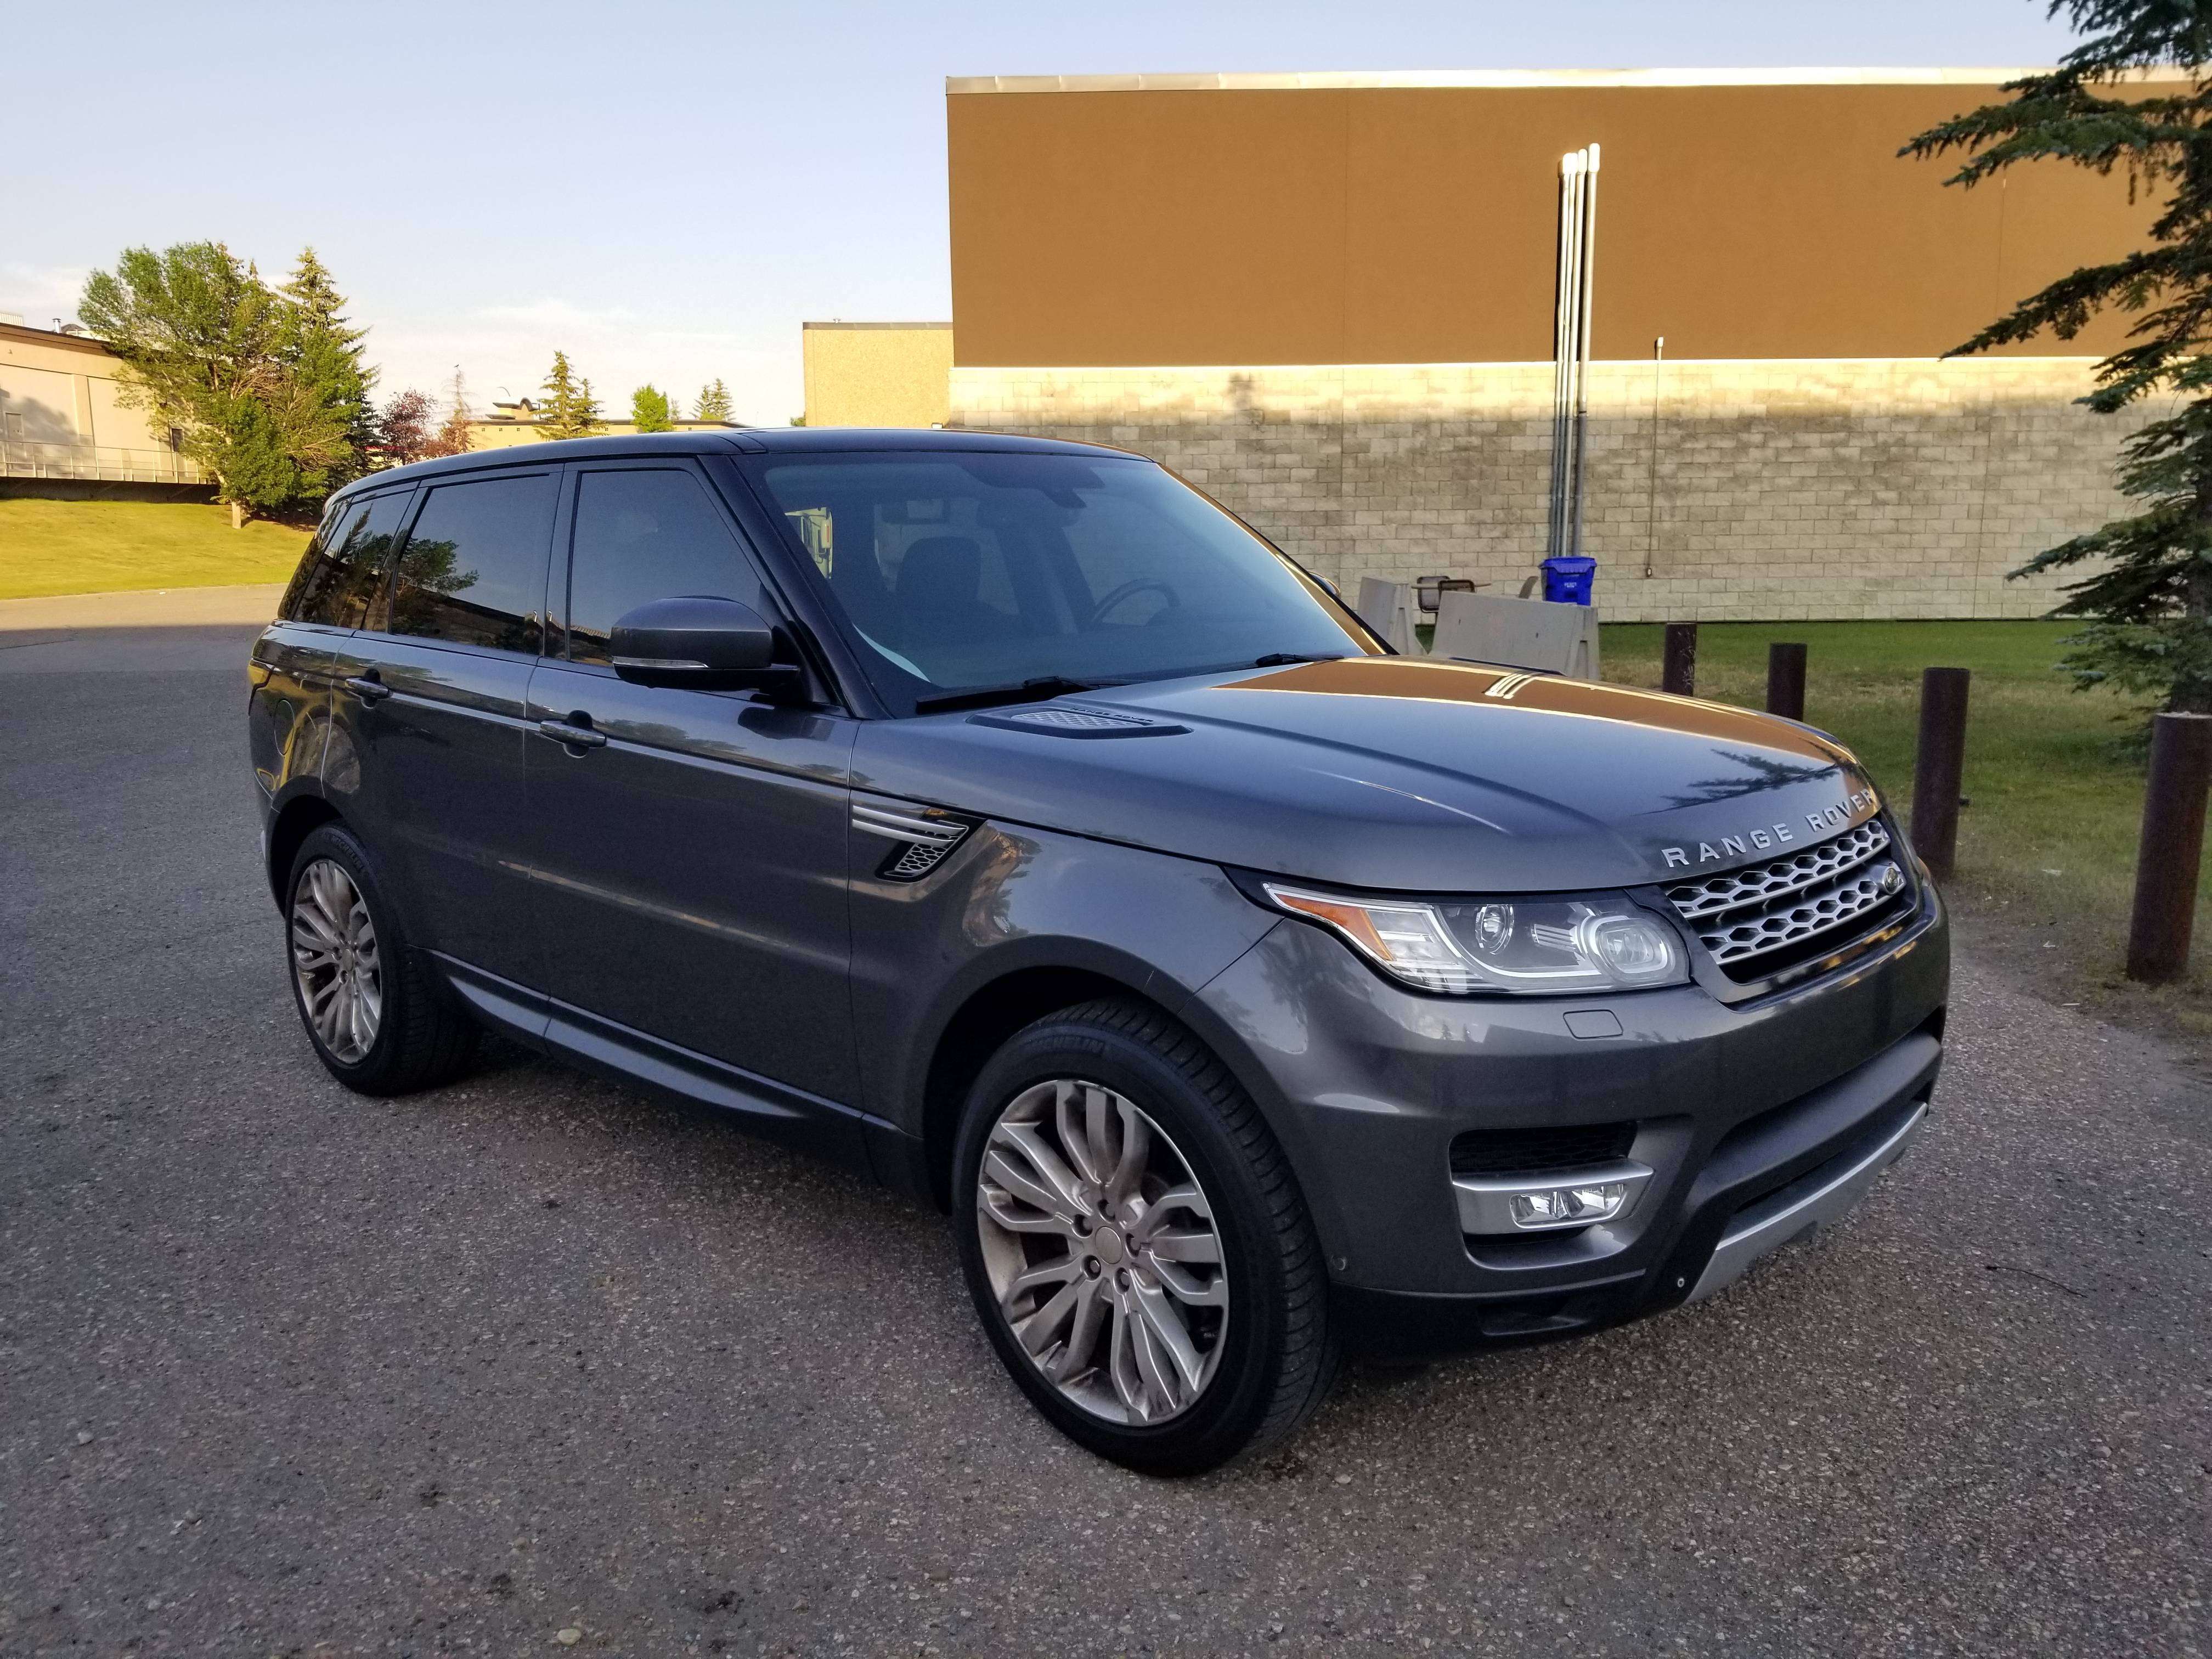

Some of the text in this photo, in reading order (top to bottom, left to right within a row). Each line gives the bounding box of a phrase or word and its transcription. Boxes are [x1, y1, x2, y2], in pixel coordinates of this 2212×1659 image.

[1070, 708, 1154, 723] RANGE ROVER
[1661, 789, 1873, 868] RANGE ROVER
